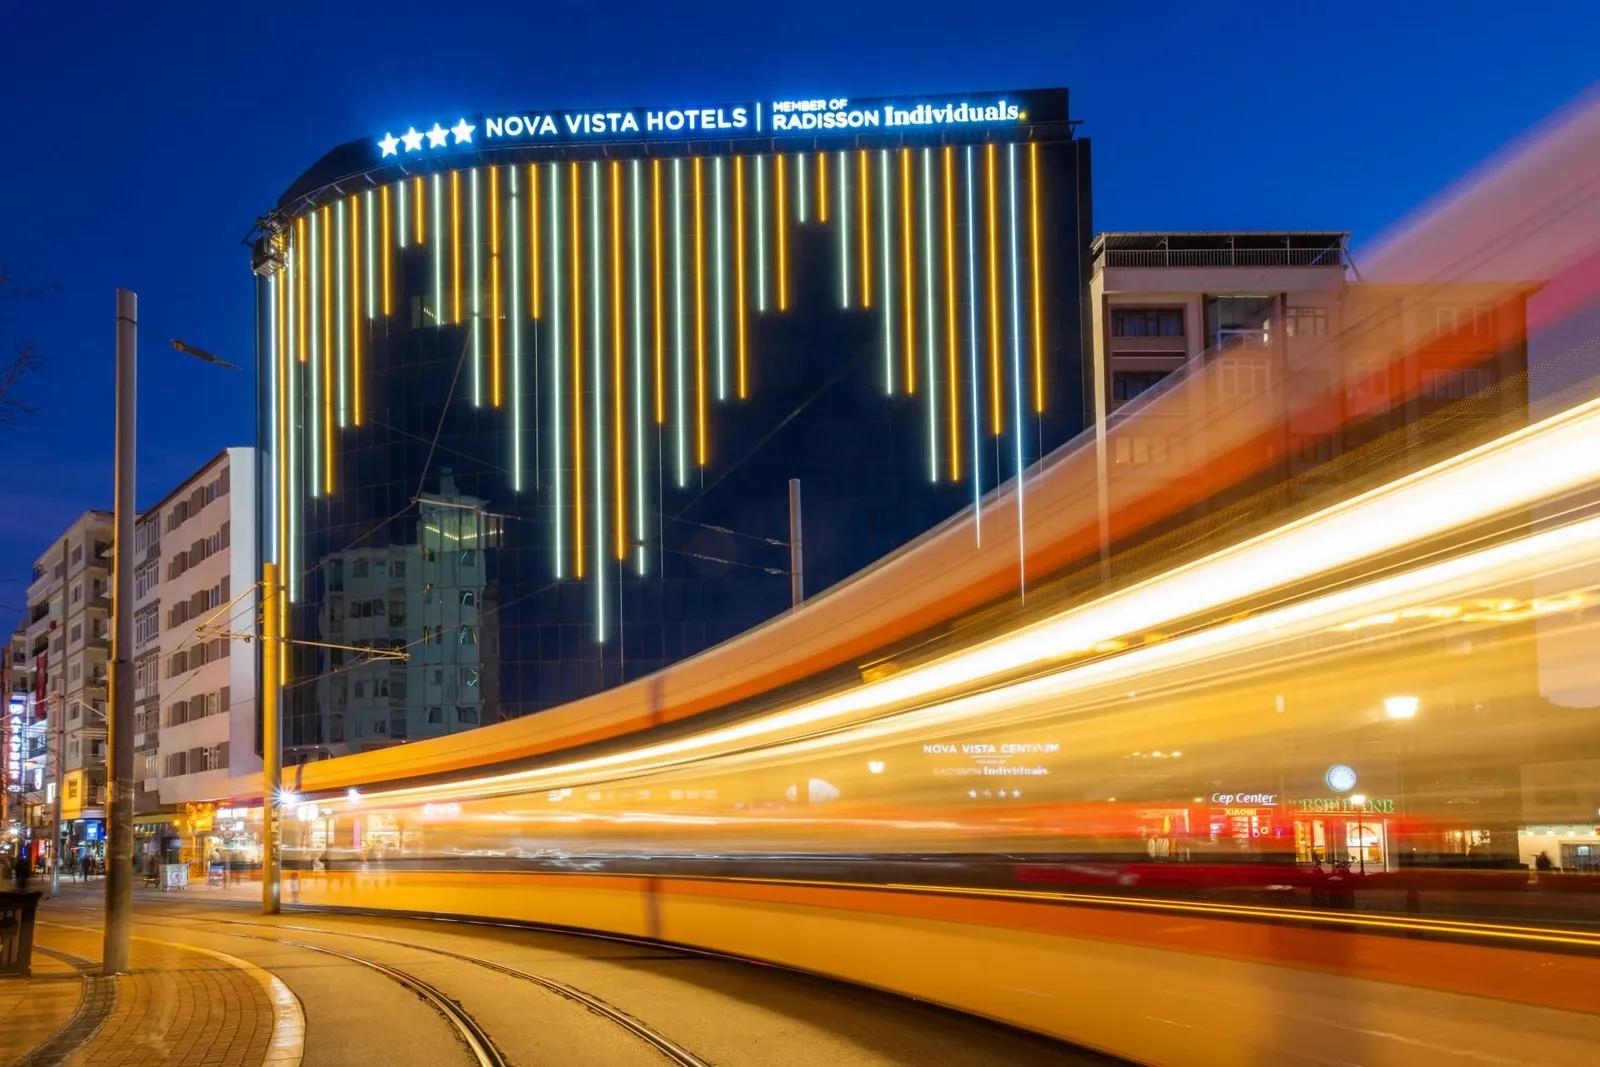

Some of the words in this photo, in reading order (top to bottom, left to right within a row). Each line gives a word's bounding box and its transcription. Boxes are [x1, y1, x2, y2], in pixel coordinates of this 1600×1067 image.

[773, 100, 827, 113] MEMBER
[828, 98, 848, 111] OF
[485, 114, 558, 138] NOVA
[565, 112, 639, 134] VISTA
[646, 108, 748, 133] HOTELS
[773, 109, 880, 130] RADISSON
[923, 744, 957, 754] NOVA
[962, 744, 996, 754] VISTA
[1212, 792, 1234, 806] Cep
[1236, 792, 1275, 804] Center
